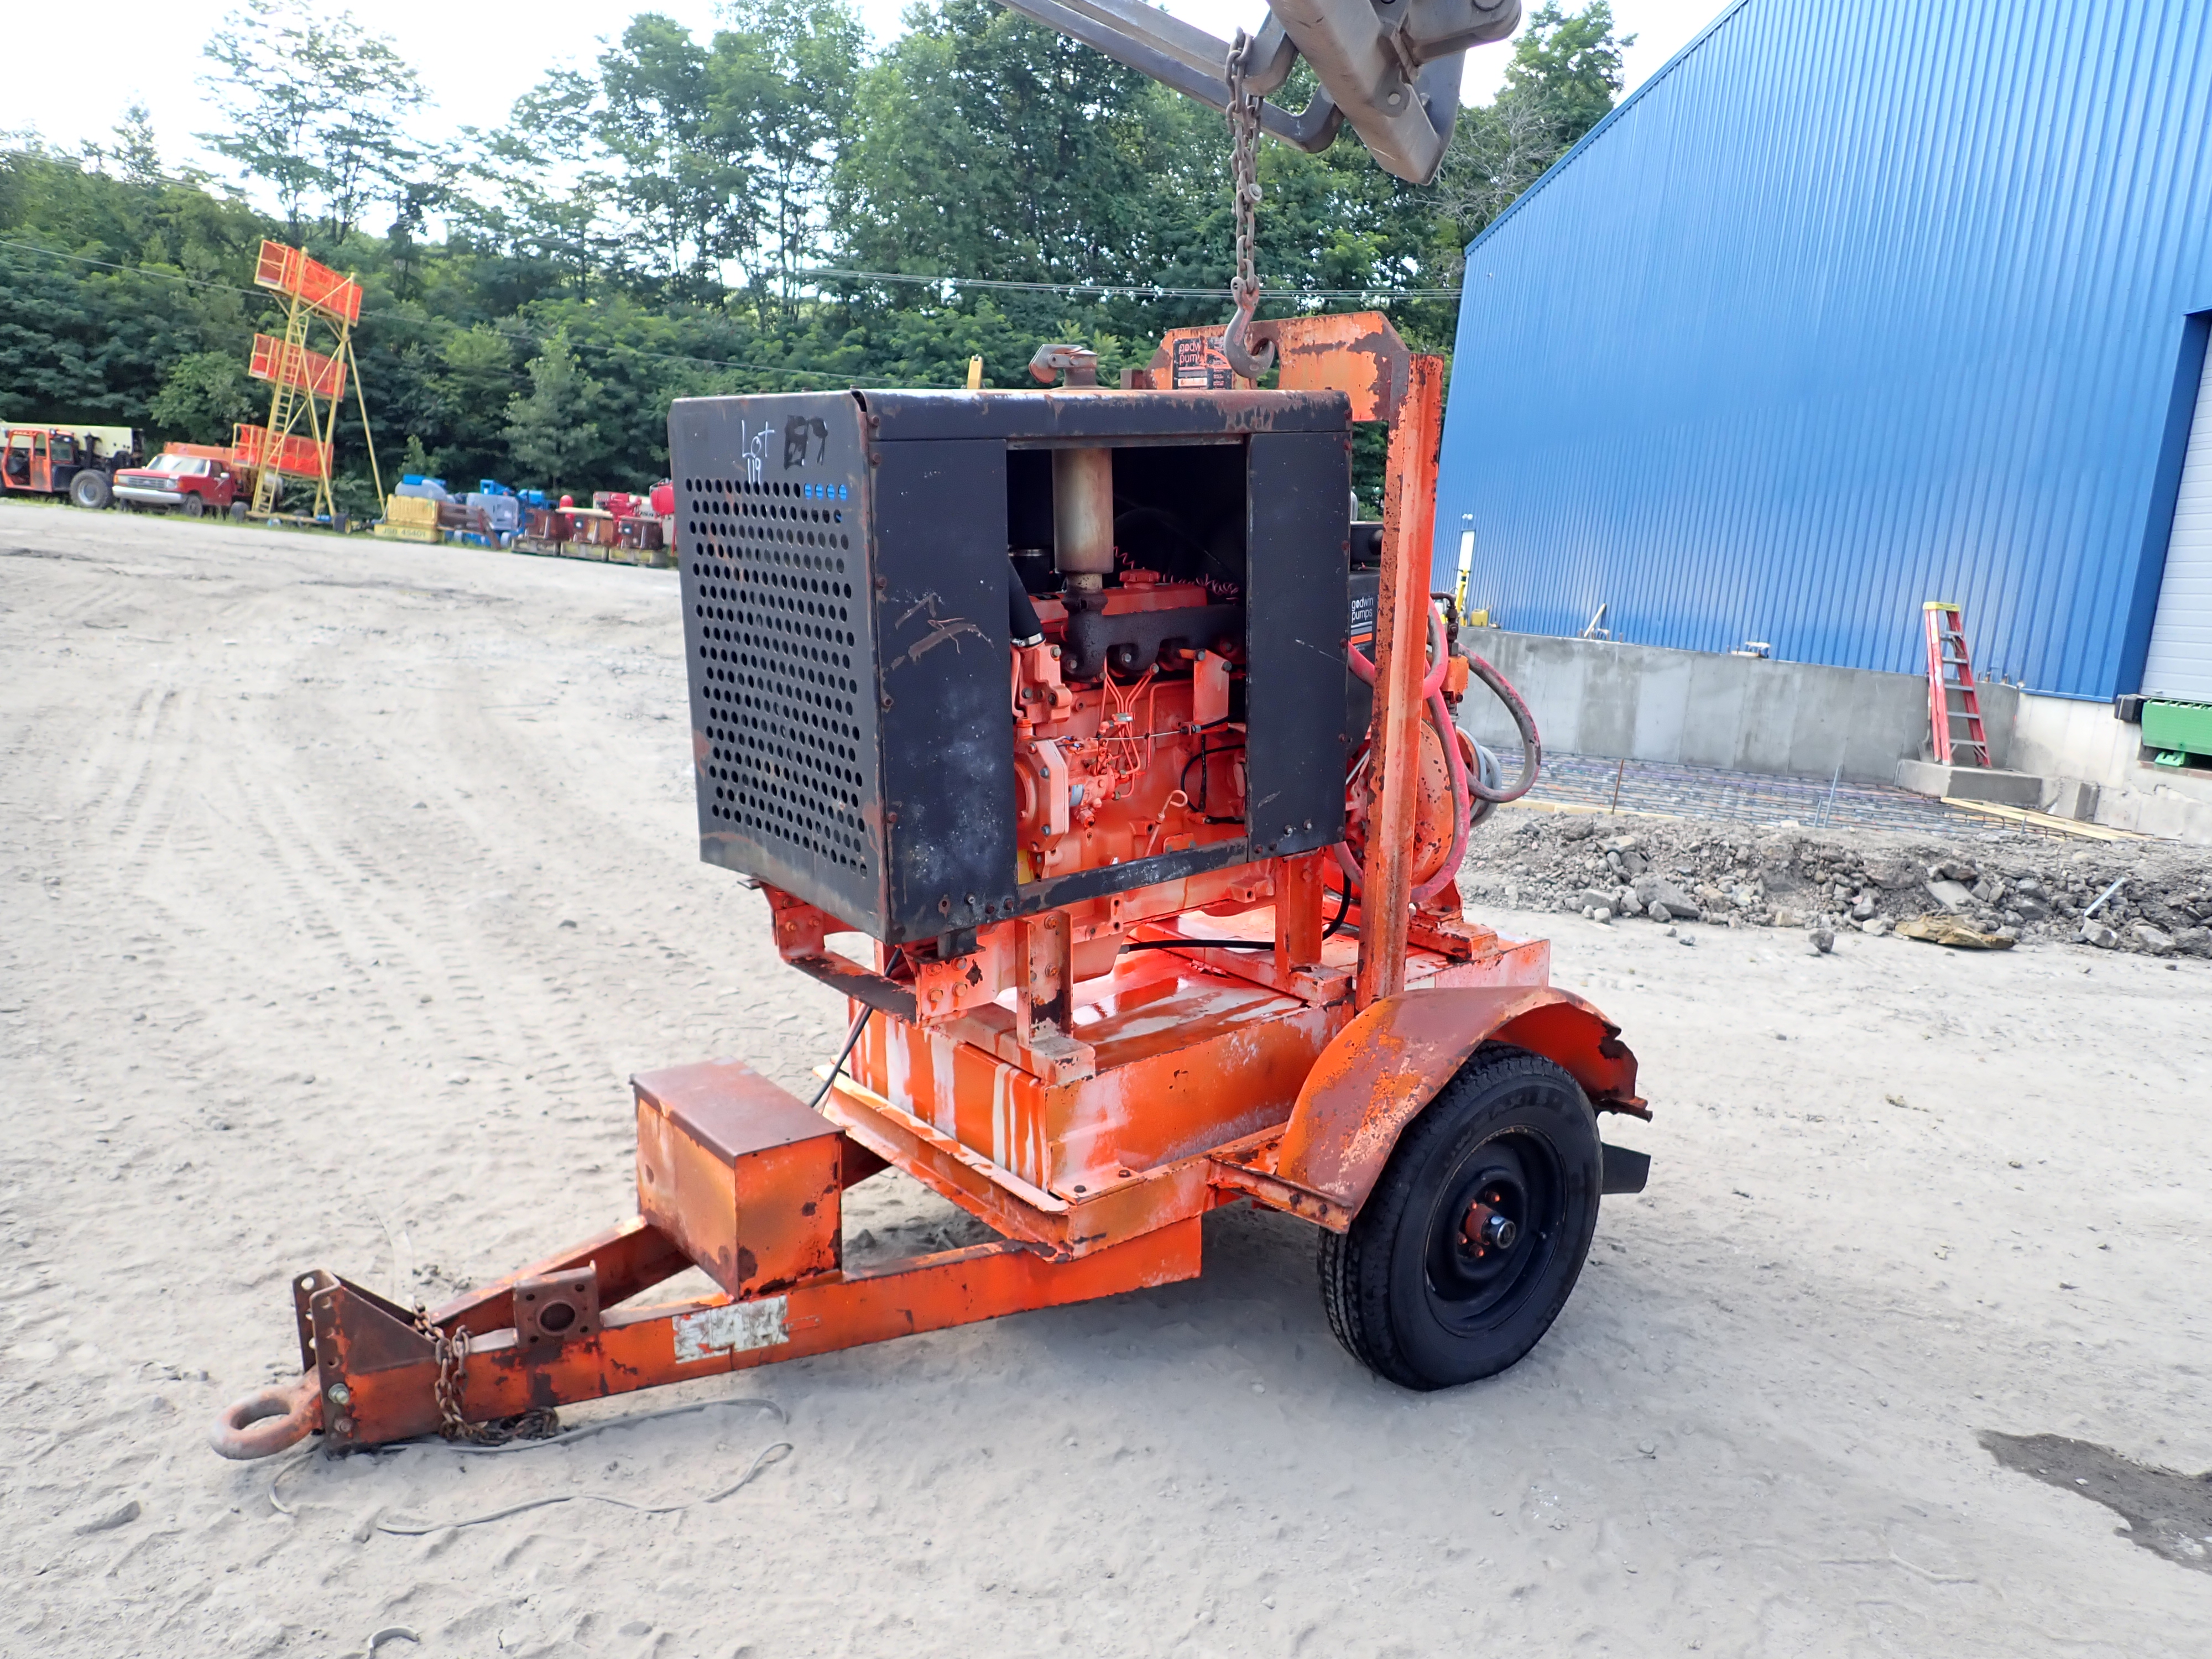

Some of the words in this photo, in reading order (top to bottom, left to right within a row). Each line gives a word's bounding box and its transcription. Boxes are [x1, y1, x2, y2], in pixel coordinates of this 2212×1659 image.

[742, 419, 774, 458] Lot
[748, 457, 761, 486] 119
[1351, 596, 1374, 612] godwin
[1352, 608, 1373, 624] pumps
